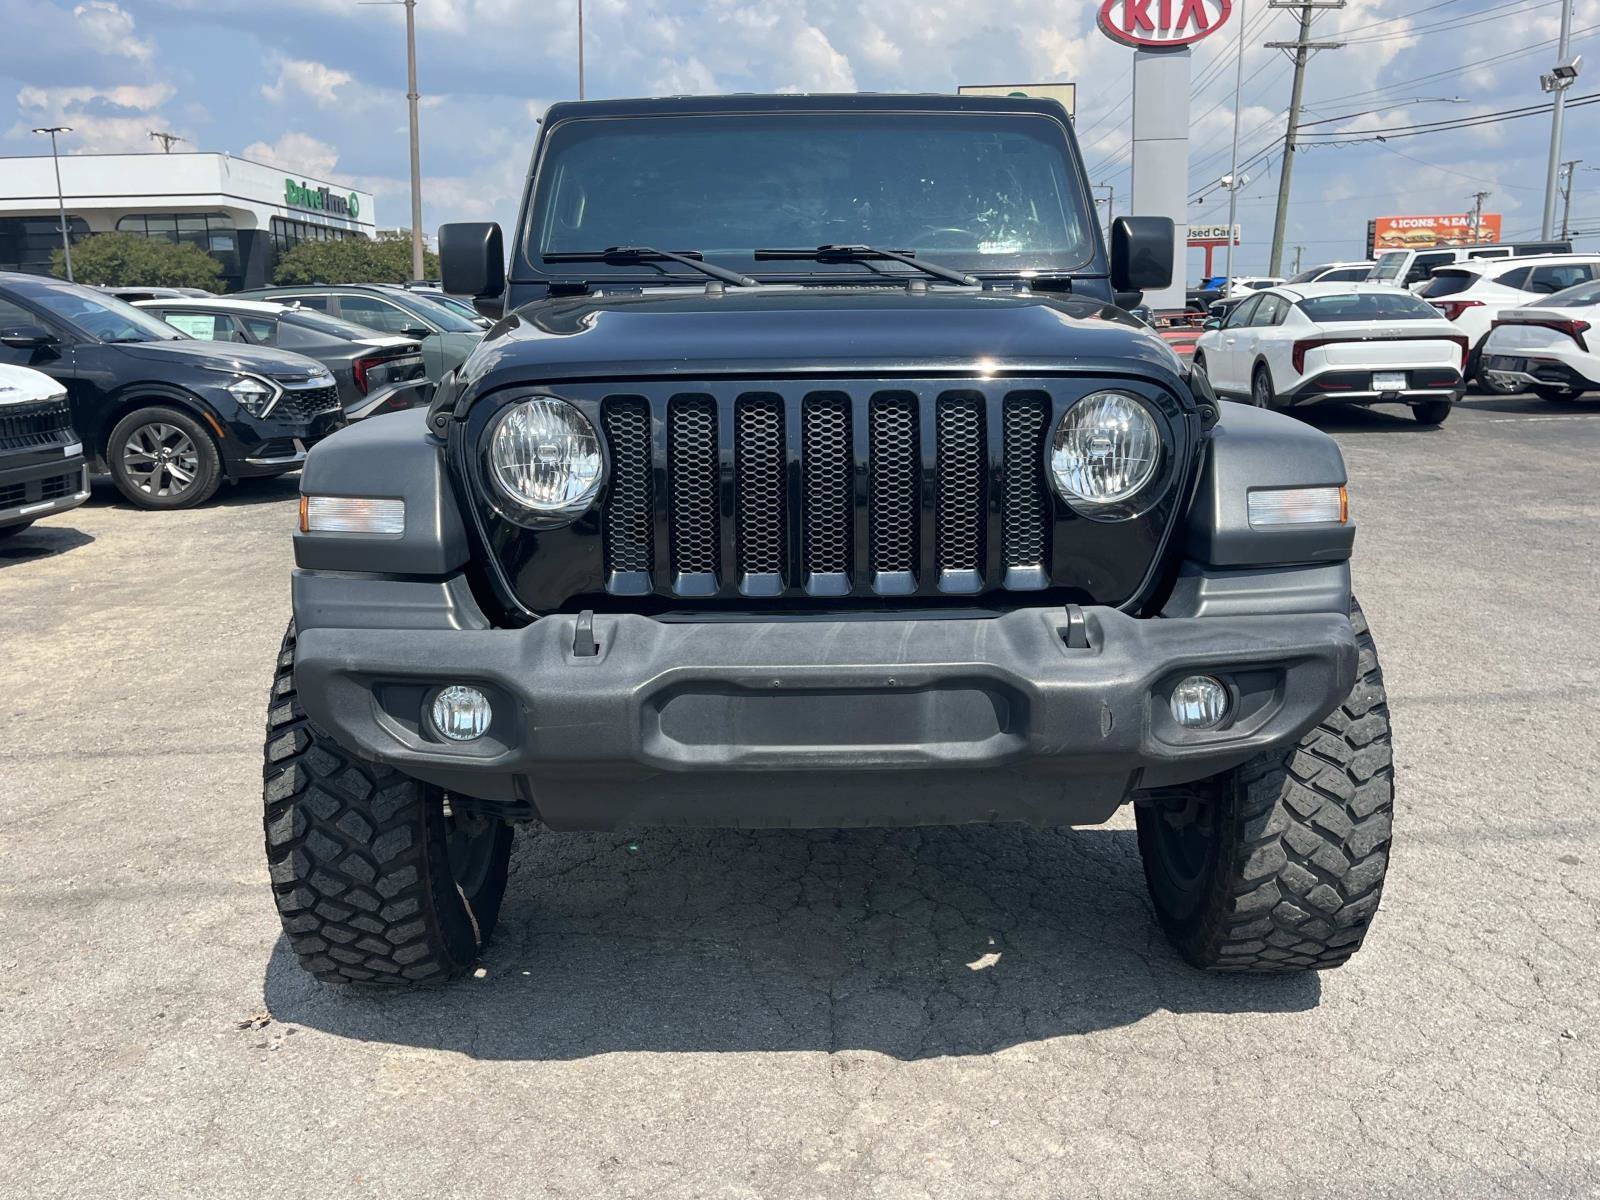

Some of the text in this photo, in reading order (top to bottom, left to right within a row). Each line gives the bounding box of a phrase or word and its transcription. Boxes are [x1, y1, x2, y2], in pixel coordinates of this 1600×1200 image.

[1125, 0, 1209, 31] KIA
[285, 178, 348, 214] DriveTime
[1390, 219, 1398, 228] 4
[1398, 218, 1437, 228] ICONS.
